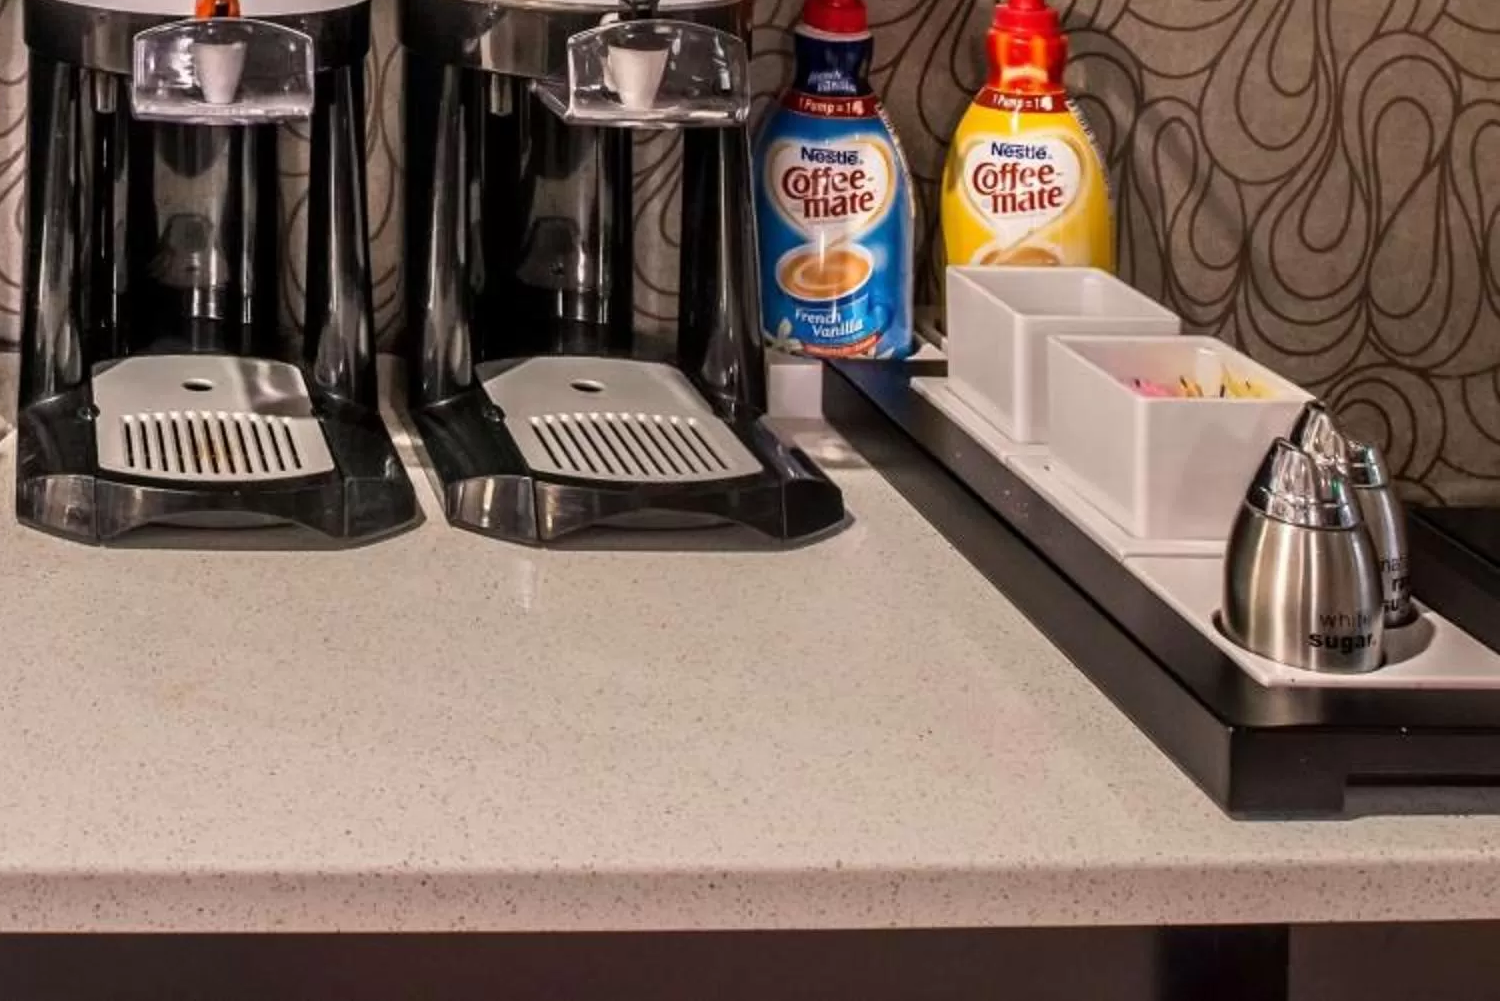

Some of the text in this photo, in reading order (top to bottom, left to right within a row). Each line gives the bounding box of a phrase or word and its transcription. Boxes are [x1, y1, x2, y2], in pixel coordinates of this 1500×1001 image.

[803, 189, 875, 219] mate
[991, 185, 1063, 214] mate
[795, 306, 841, 324] French
[812, 317, 864, 338] Vanilla
